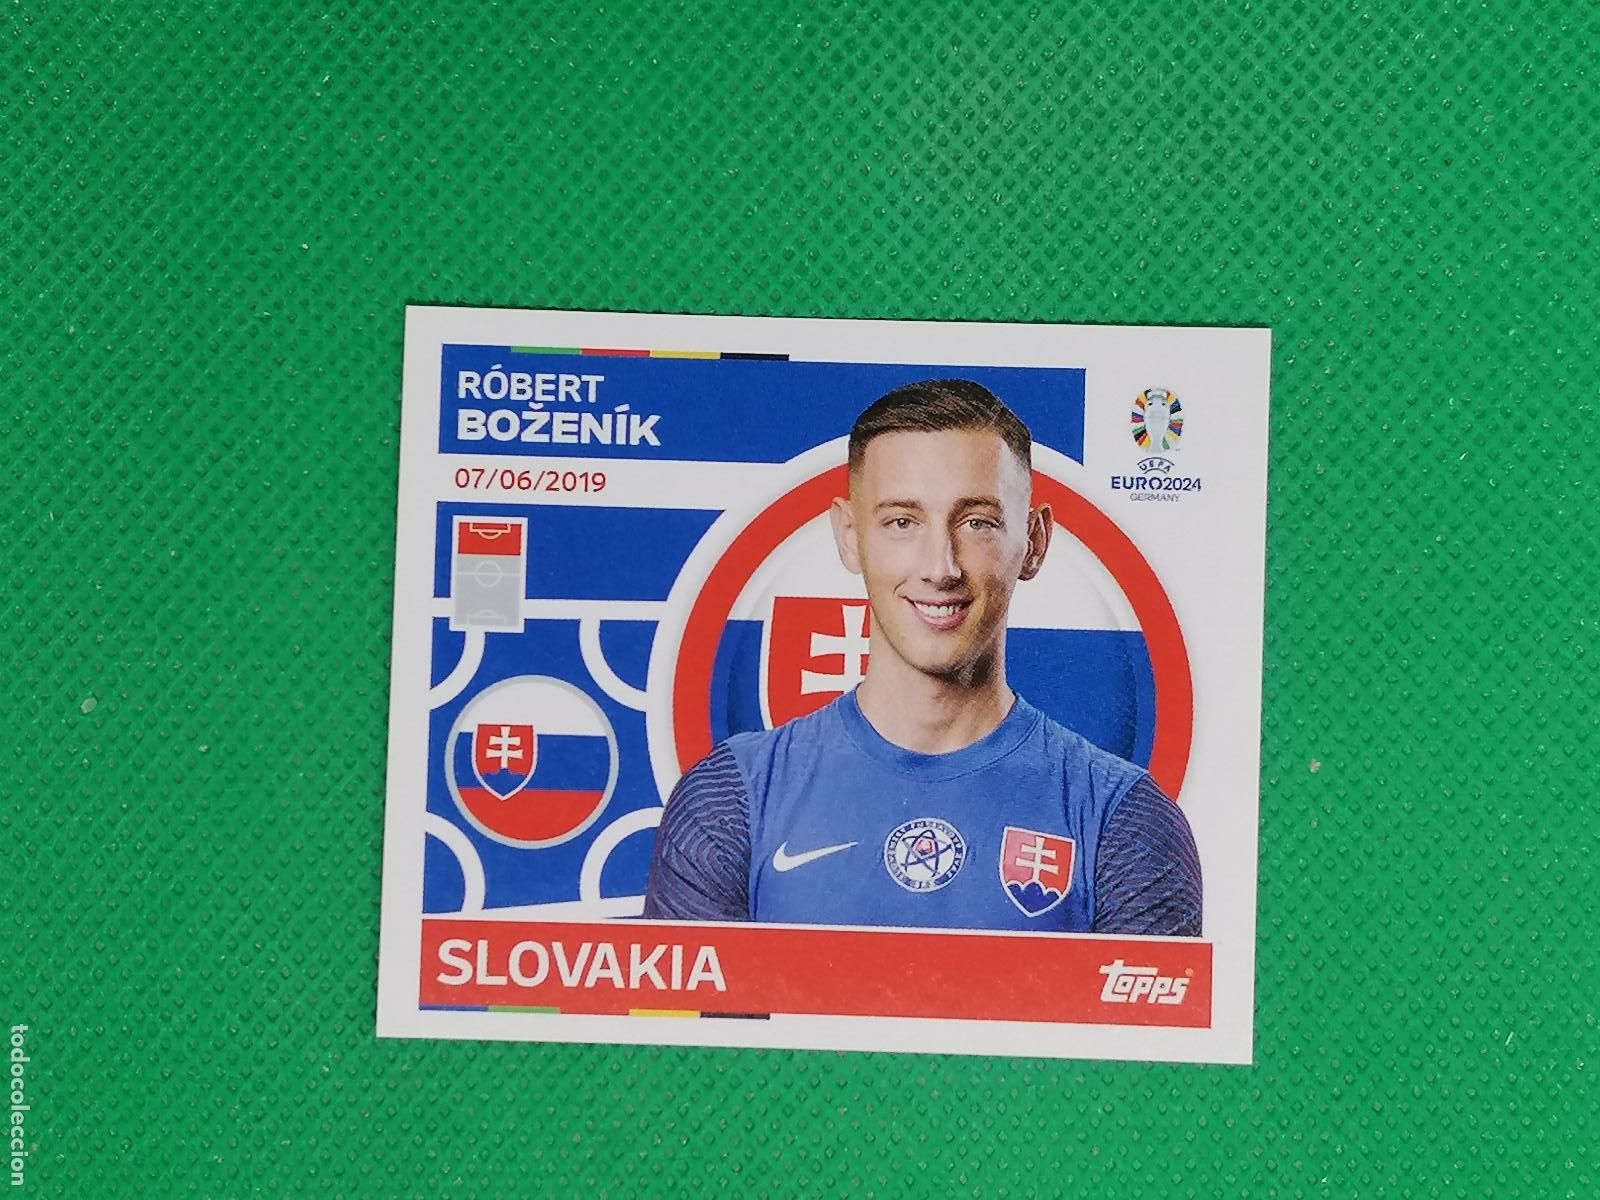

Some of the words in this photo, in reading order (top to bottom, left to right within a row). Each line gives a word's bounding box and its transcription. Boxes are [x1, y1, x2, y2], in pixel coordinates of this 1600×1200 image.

[458, 364, 605, 403] RÓBERT
[457, 402, 662, 446] BOŽENÍK
[455, 468, 606, 492] 07/06/2019
[437, 938, 727, 992] SLOVAKIA
